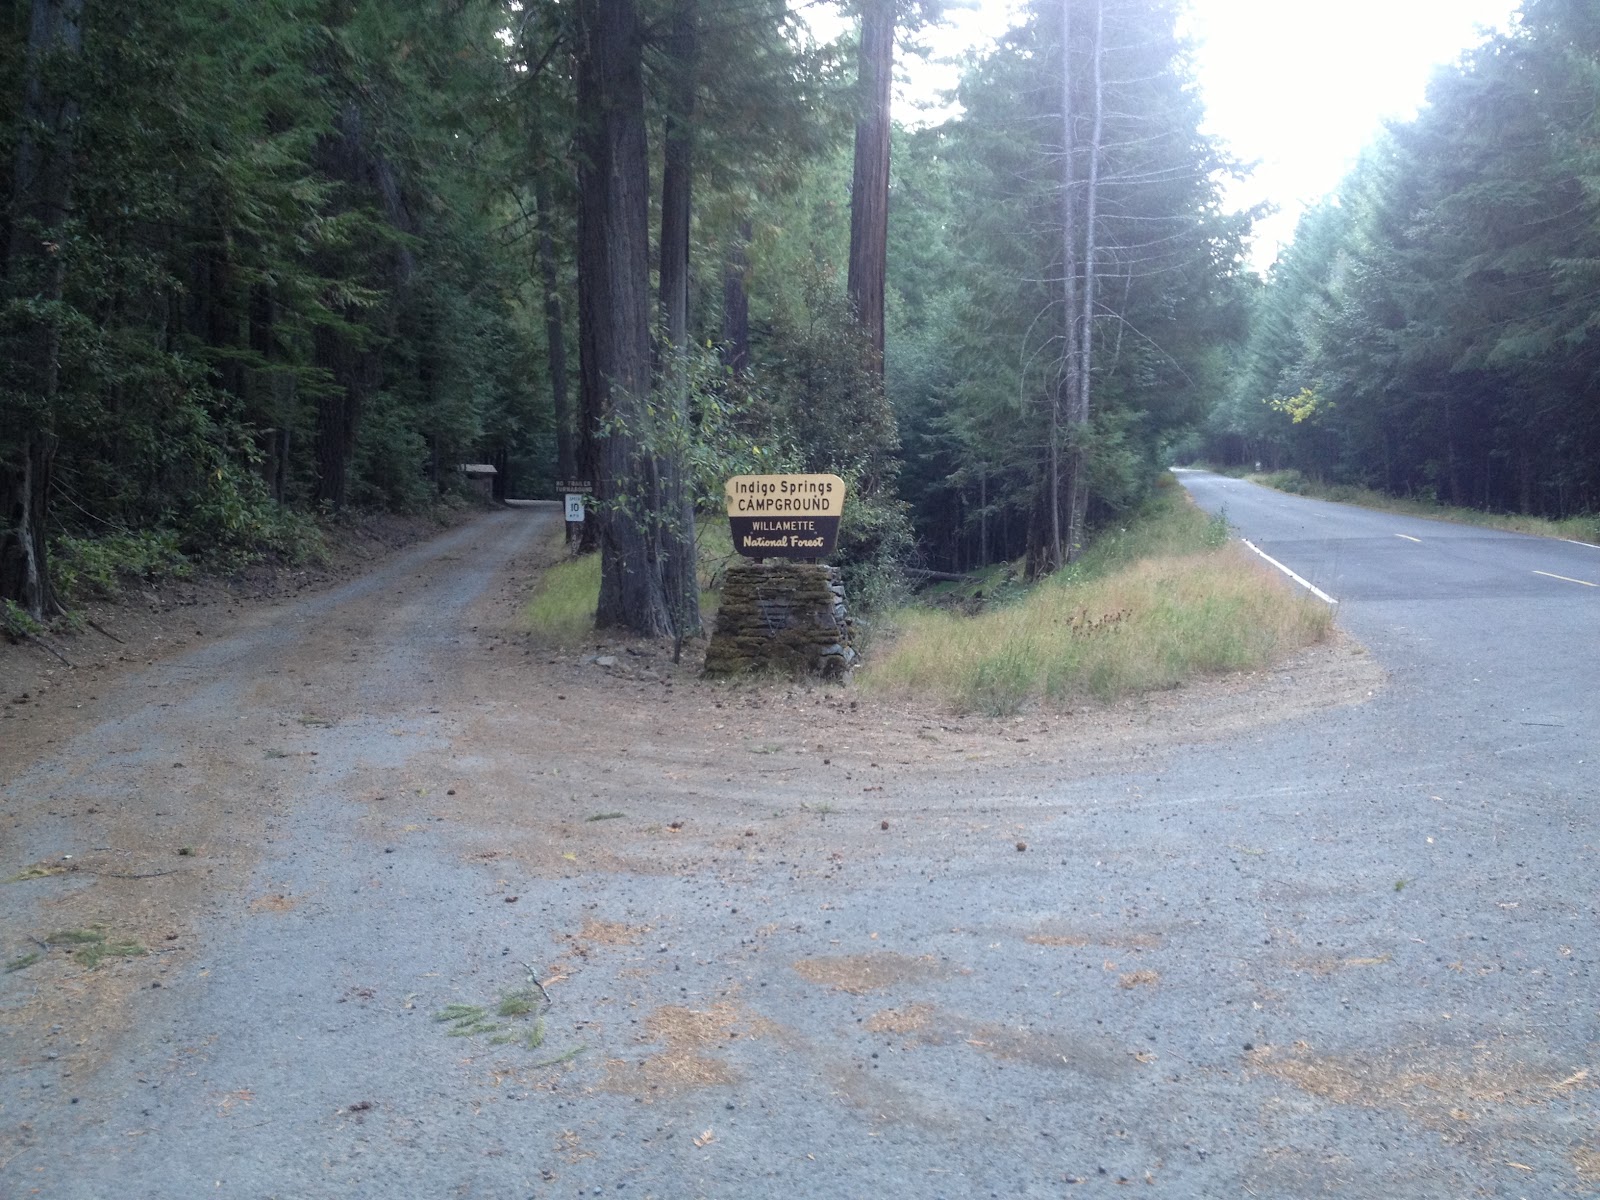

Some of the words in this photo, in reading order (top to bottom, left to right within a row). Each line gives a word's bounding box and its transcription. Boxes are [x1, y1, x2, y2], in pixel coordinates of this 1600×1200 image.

[735, 481, 776, 497] Indigo
[780, 480, 833, 496] Springs
[570, 503, 580, 512] 10
[738, 498, 830, 511] CAMPGROUND
[752, 521, 815, 531] WILLAMETTE
[743, 535, 788, 547] National
[790, 535, 824, 547] Forest
